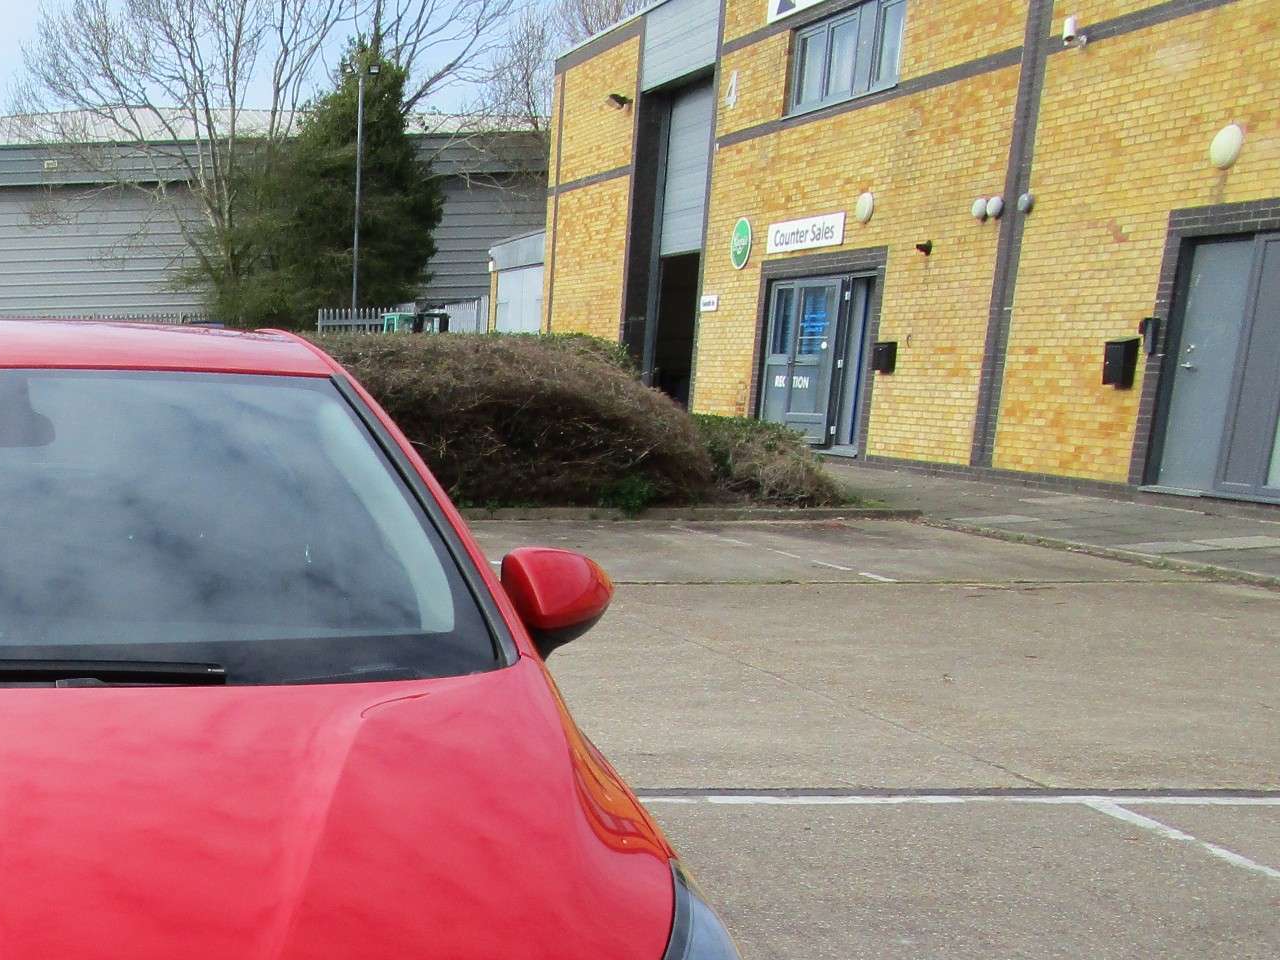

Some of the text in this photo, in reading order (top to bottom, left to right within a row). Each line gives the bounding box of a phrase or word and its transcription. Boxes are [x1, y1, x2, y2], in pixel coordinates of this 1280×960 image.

[724, 70, 738, 110] 4
[774, 227, 809, 248] Counter
[810, 221, 835, 243] Sales
